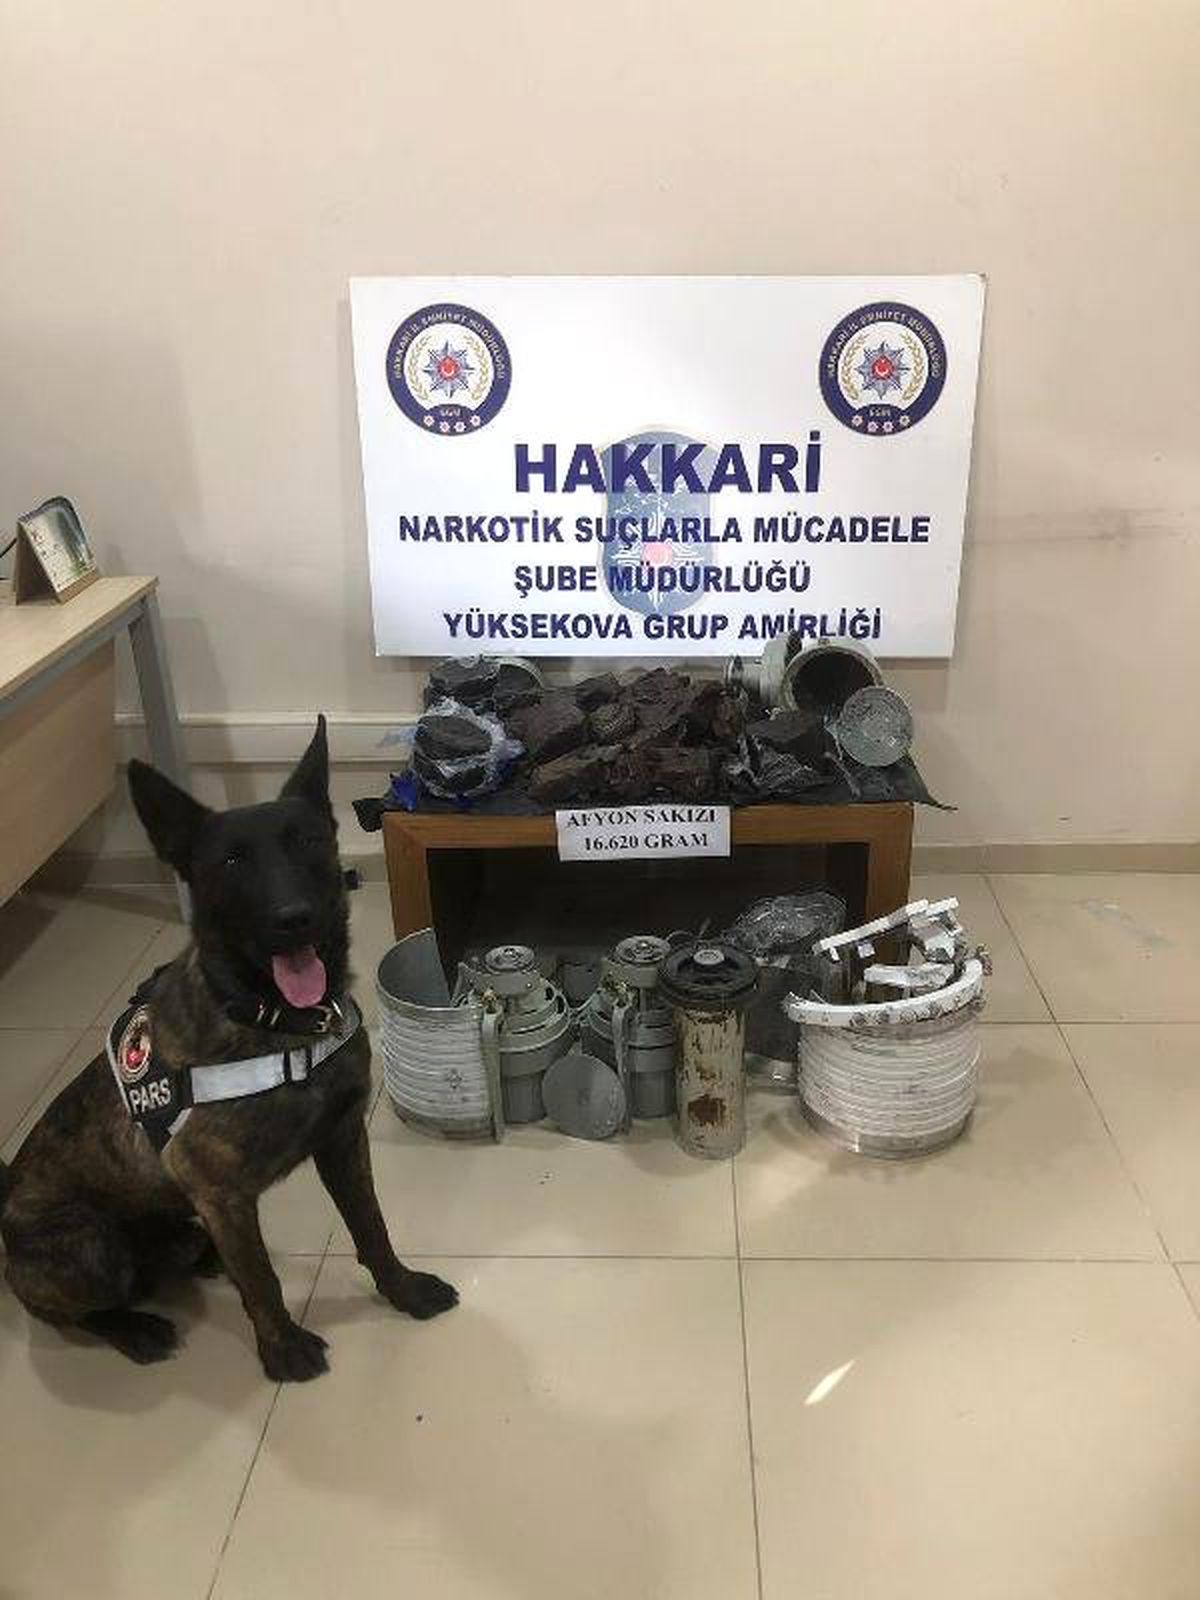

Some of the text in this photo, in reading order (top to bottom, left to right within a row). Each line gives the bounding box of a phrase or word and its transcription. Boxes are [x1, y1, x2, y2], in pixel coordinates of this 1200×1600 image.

[515, 430, 822, 493] HAKKARİ
[399, 510, 930, 550] NARKOTİK SUÇLARLA MÜCADELE
[514, 560, 811, 598] ŞUBE MÜDÜRLÜĞÜ
[443, 608, 881, 640] YÜKSEKOVA GRUP AMİRLİĞİ
[567, 809, 716, 828] AFYON SAKIZI
[584, 833, 709, 851] 16.620 GRAM
[129, 1078, 172, 1115] PARS
